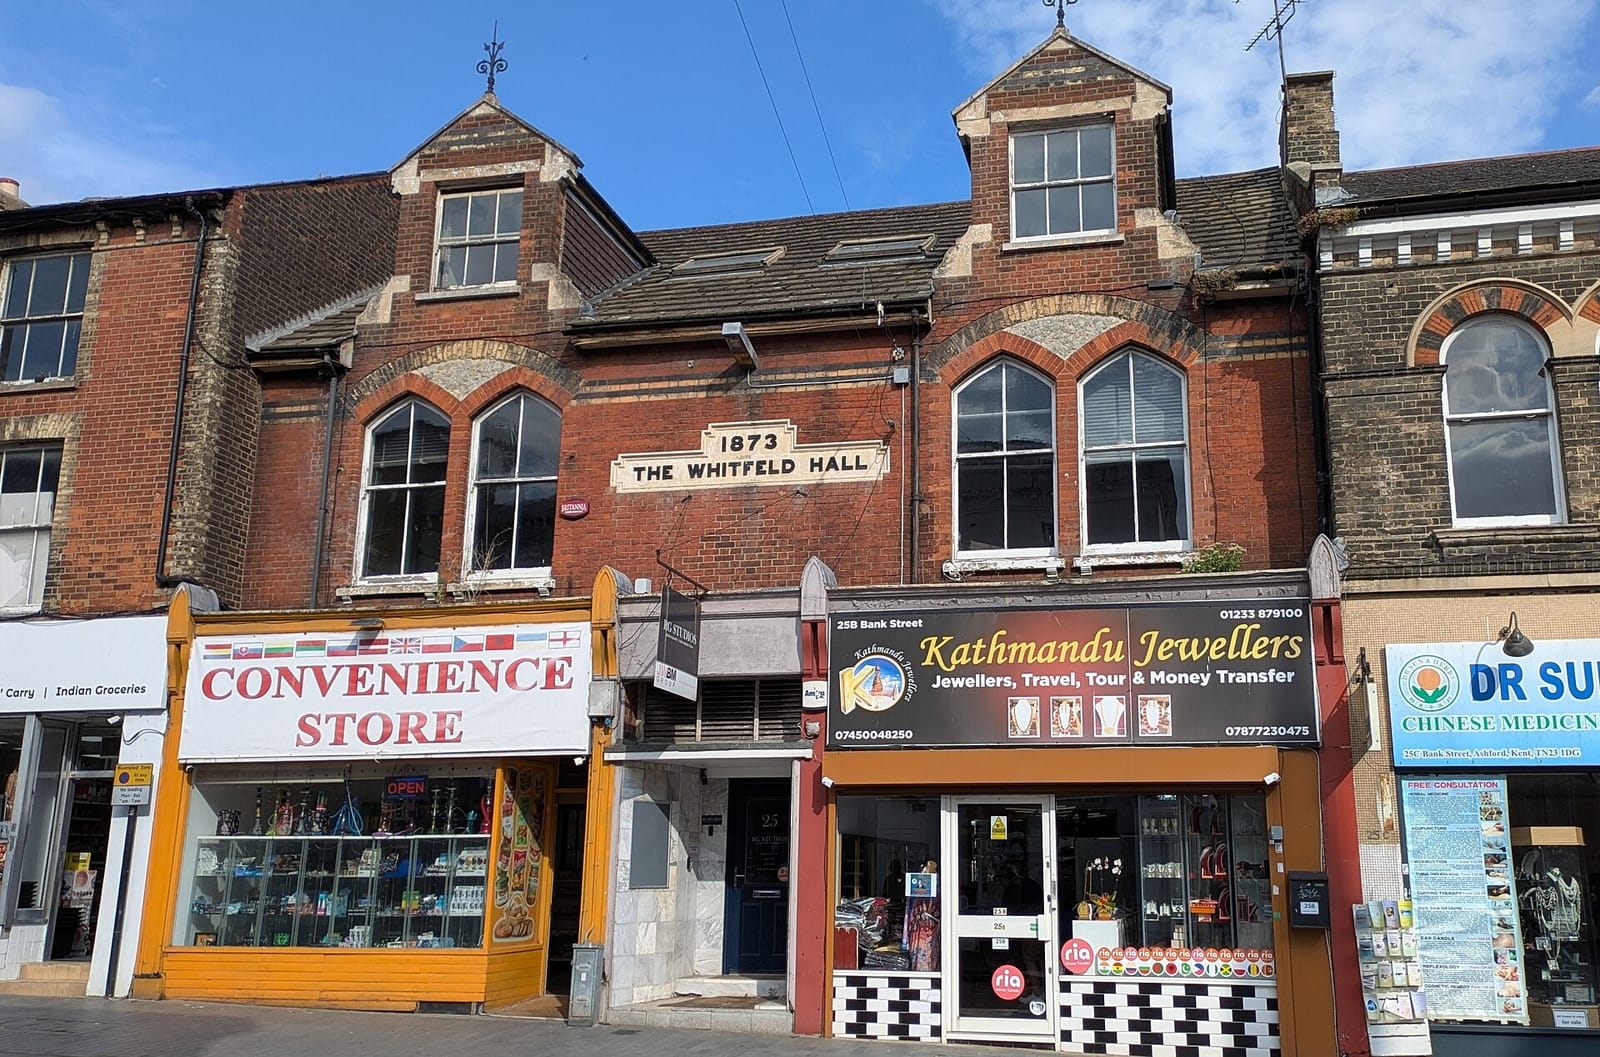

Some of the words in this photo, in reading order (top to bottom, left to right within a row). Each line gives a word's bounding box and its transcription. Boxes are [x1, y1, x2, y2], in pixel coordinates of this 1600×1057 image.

[721, 433, 778, 452] 1873
[633, 464, 673, 481] THE
[687, 459, 795, 479] WHITFELD
[809, 455, 868, 473] HALL
[1220, 609, 1255, 619] 01233
[1258, 608, 1303, 619] 879100
[837, 620, 858, 630] 25B
[860, 619, 887, 629] Bank
[889, 618, 923, 628] Street
[673, 623, 697, 645] STUDIOS
[919, 627, 1125, 672] Kathmandu
[1134, 623, 1303, 667] Jewellers
[201, 656, 574, 700] CONVENIENCE
[853, 643, 904, 664] Kathmandu
[901, 659, 918, 703] Jewellers
[931, 672, 1017, 690] Jewellers,
[1021, 671, 1080, 688] Travel,
[1085, 671, 1126, 686] Tour
[1132, 671, 1145, 685] &
[1150, 670, 1211, 687] Money
[1216, 669, 1295, 684] Transfer
[1469, 663, 1527, 701] DR
[1539, 661, 1600, 701] SU
[5, 688, 35, 699] Carry
[56, 686, 92, 697] Indian
[95, 684, 146, 695] Groceries
[296, 711, 463, 748] STORE
[1402, 715, 1496, 731] CHINESE
[1502, 714, 1600, 731] MEDICIN
[835, 730, 913, 740] 07450048250
[1225, 726, 1310, 737] 07877230475
[1404, 750, 1420, 758] 25C
[1422, 750, 1444, 758] Bank
[1446, 750, 1472, 759] Street,
[1473, 749, 1510, 759] Ashford,
[1511, 749, 1534, 759] Kent,
[1535, 749, 1559, 758] TN23
[1560, 749, 1581, 758] 1DG
[387, 782, 425, 795] OPEN
[1433, 781, 1498, 789] CONSULTATION
[762, 814, 778, 827] 25
[1065, 942, 1091, 960] ria
[1099, 949, 1109, 957] ria
[1112, 949, 1123, 957] ria
[1138, 949, 1149, 957] ria
[1152, 949, 1163, 957] ria
[1165, 949, 1177, 957] ria
[1220, 950, 1231, 958] ria
[1233, 950, 1245, 958] ria
[1247, 950, 1259, 958] ria
[1261, 950, 1272, 958] ria
[995, 969, 1021, 987] ria
